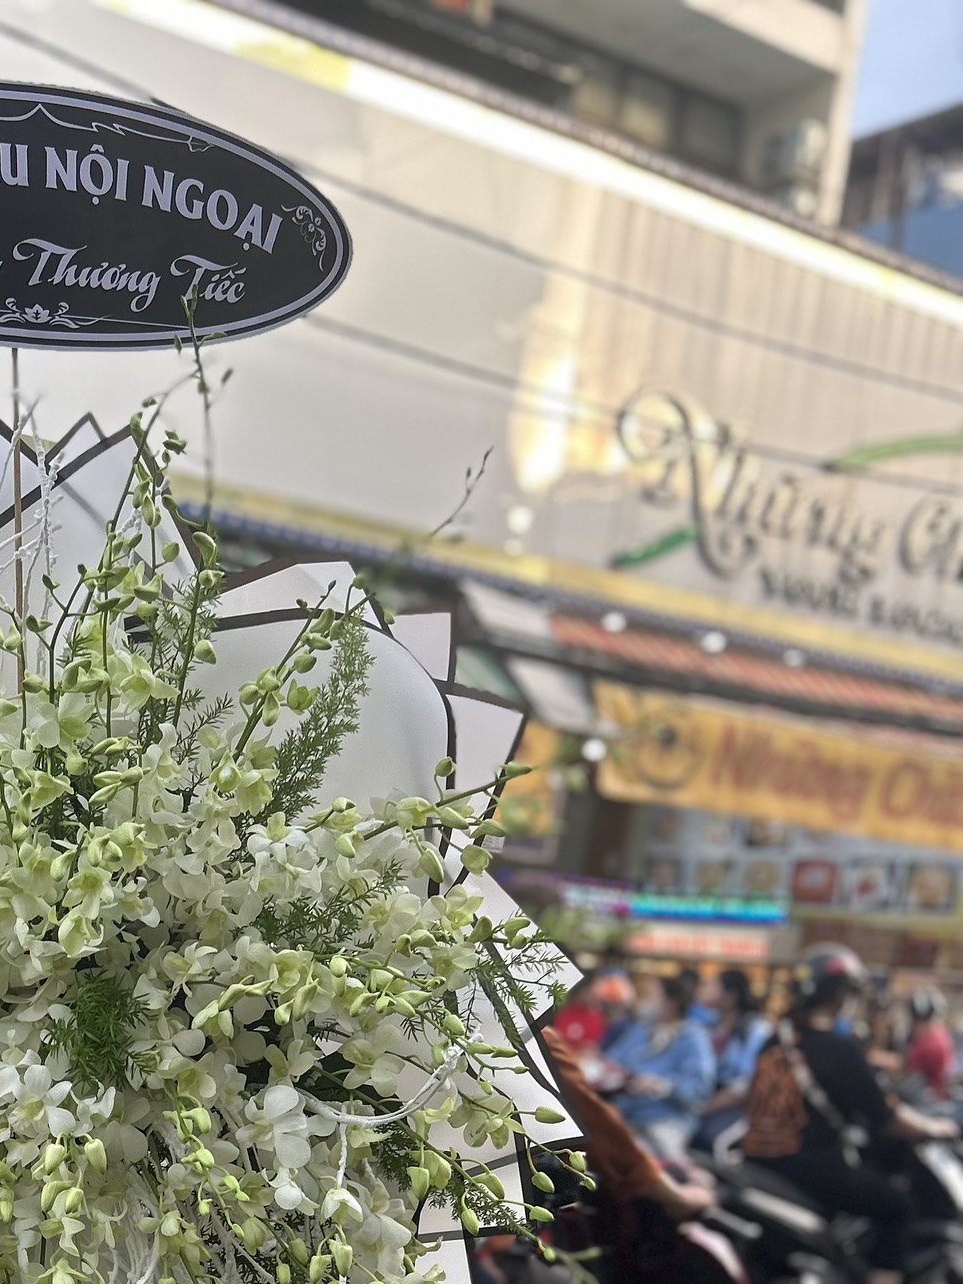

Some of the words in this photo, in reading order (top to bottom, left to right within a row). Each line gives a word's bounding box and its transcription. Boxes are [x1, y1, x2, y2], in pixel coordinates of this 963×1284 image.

[44, 143, 130, 206] NỘI
[141, 164, 284, 255] NGOẠI
[12, 238, 162, 313] Thương
[170, 254, 248, 304] Tiếc
